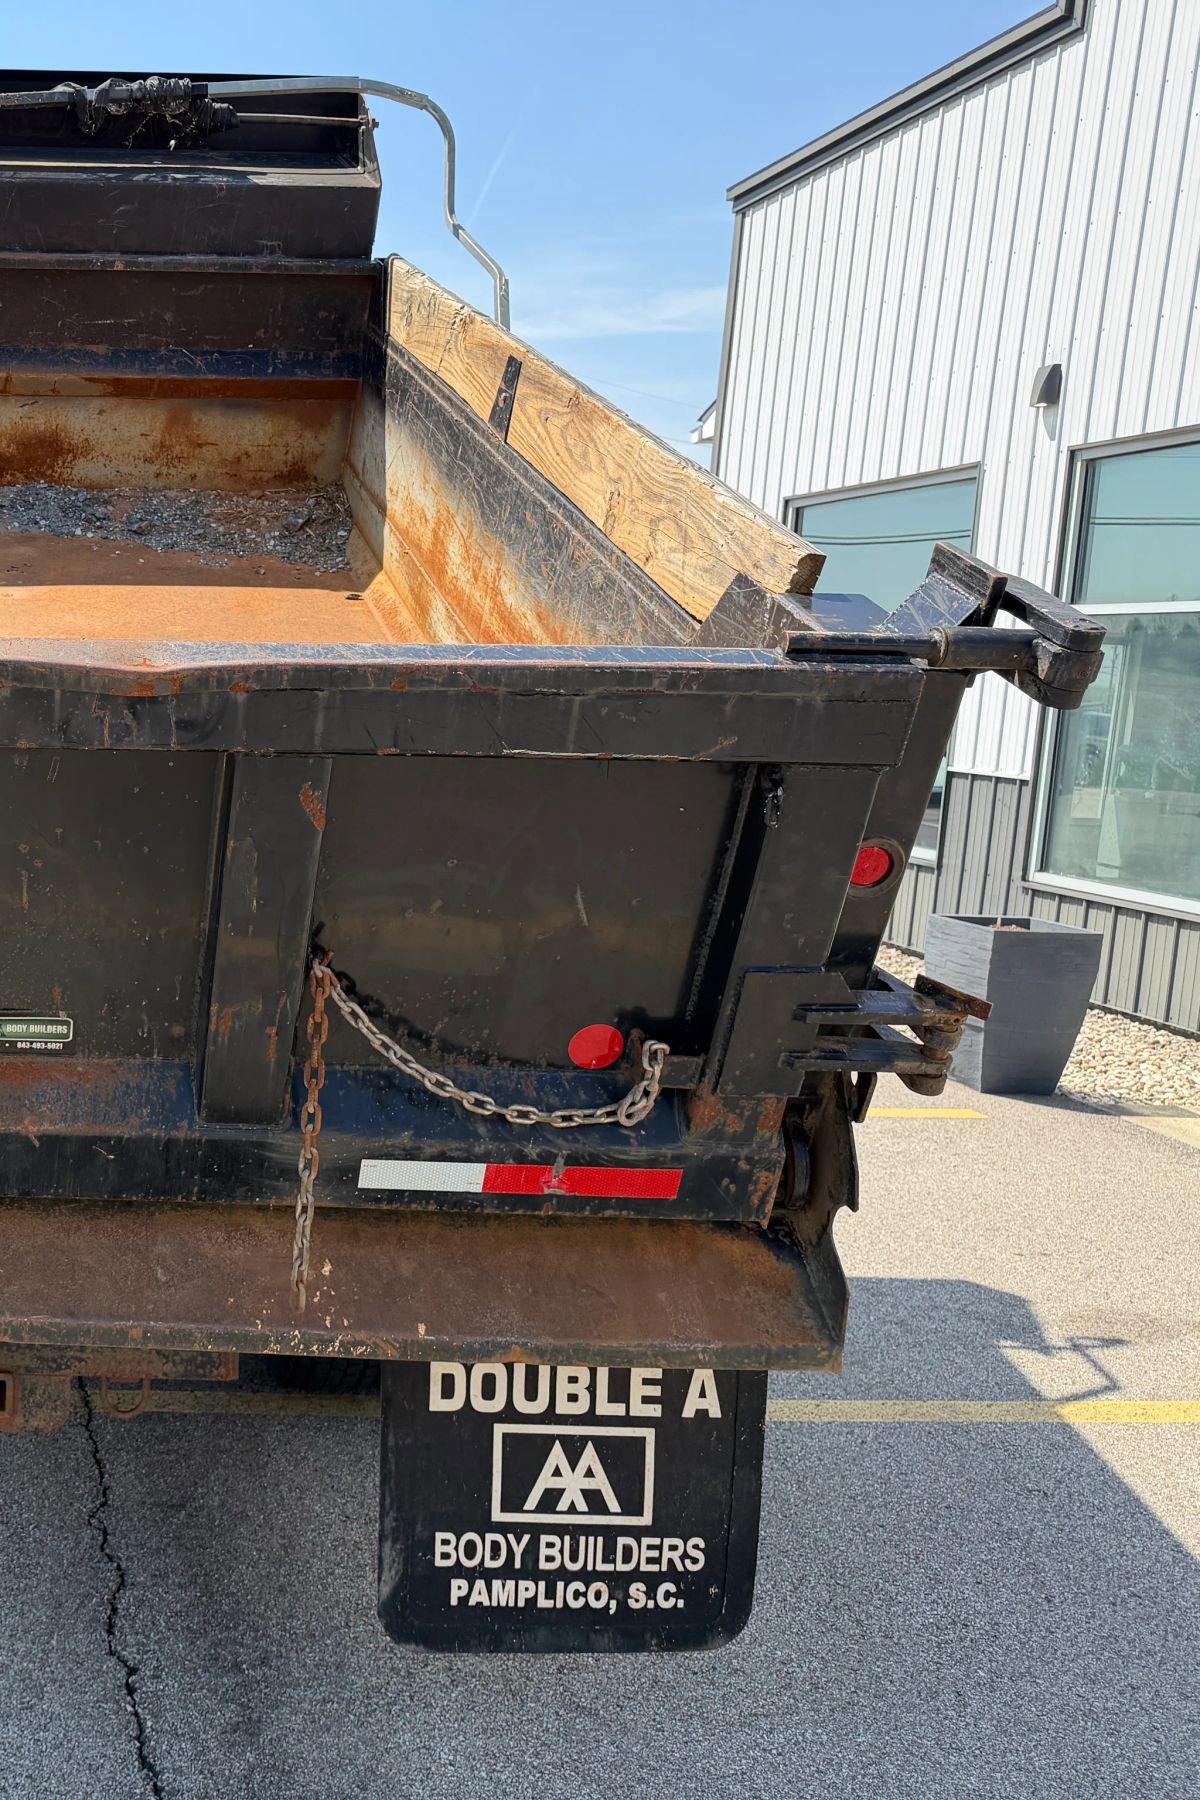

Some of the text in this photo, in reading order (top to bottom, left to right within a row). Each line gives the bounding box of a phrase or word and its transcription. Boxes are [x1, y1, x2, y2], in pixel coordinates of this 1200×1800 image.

[6, 1024, 27, 1033] BODY
[29, 1024, 68, 1034] BUILDERS
[429, 1361, 722, 1418] DOUBLE A
[434, 1531, 706, 1572] BODY BUILDERS
[450, 1578, 685, 1615] PAMPLICO, S.C.
